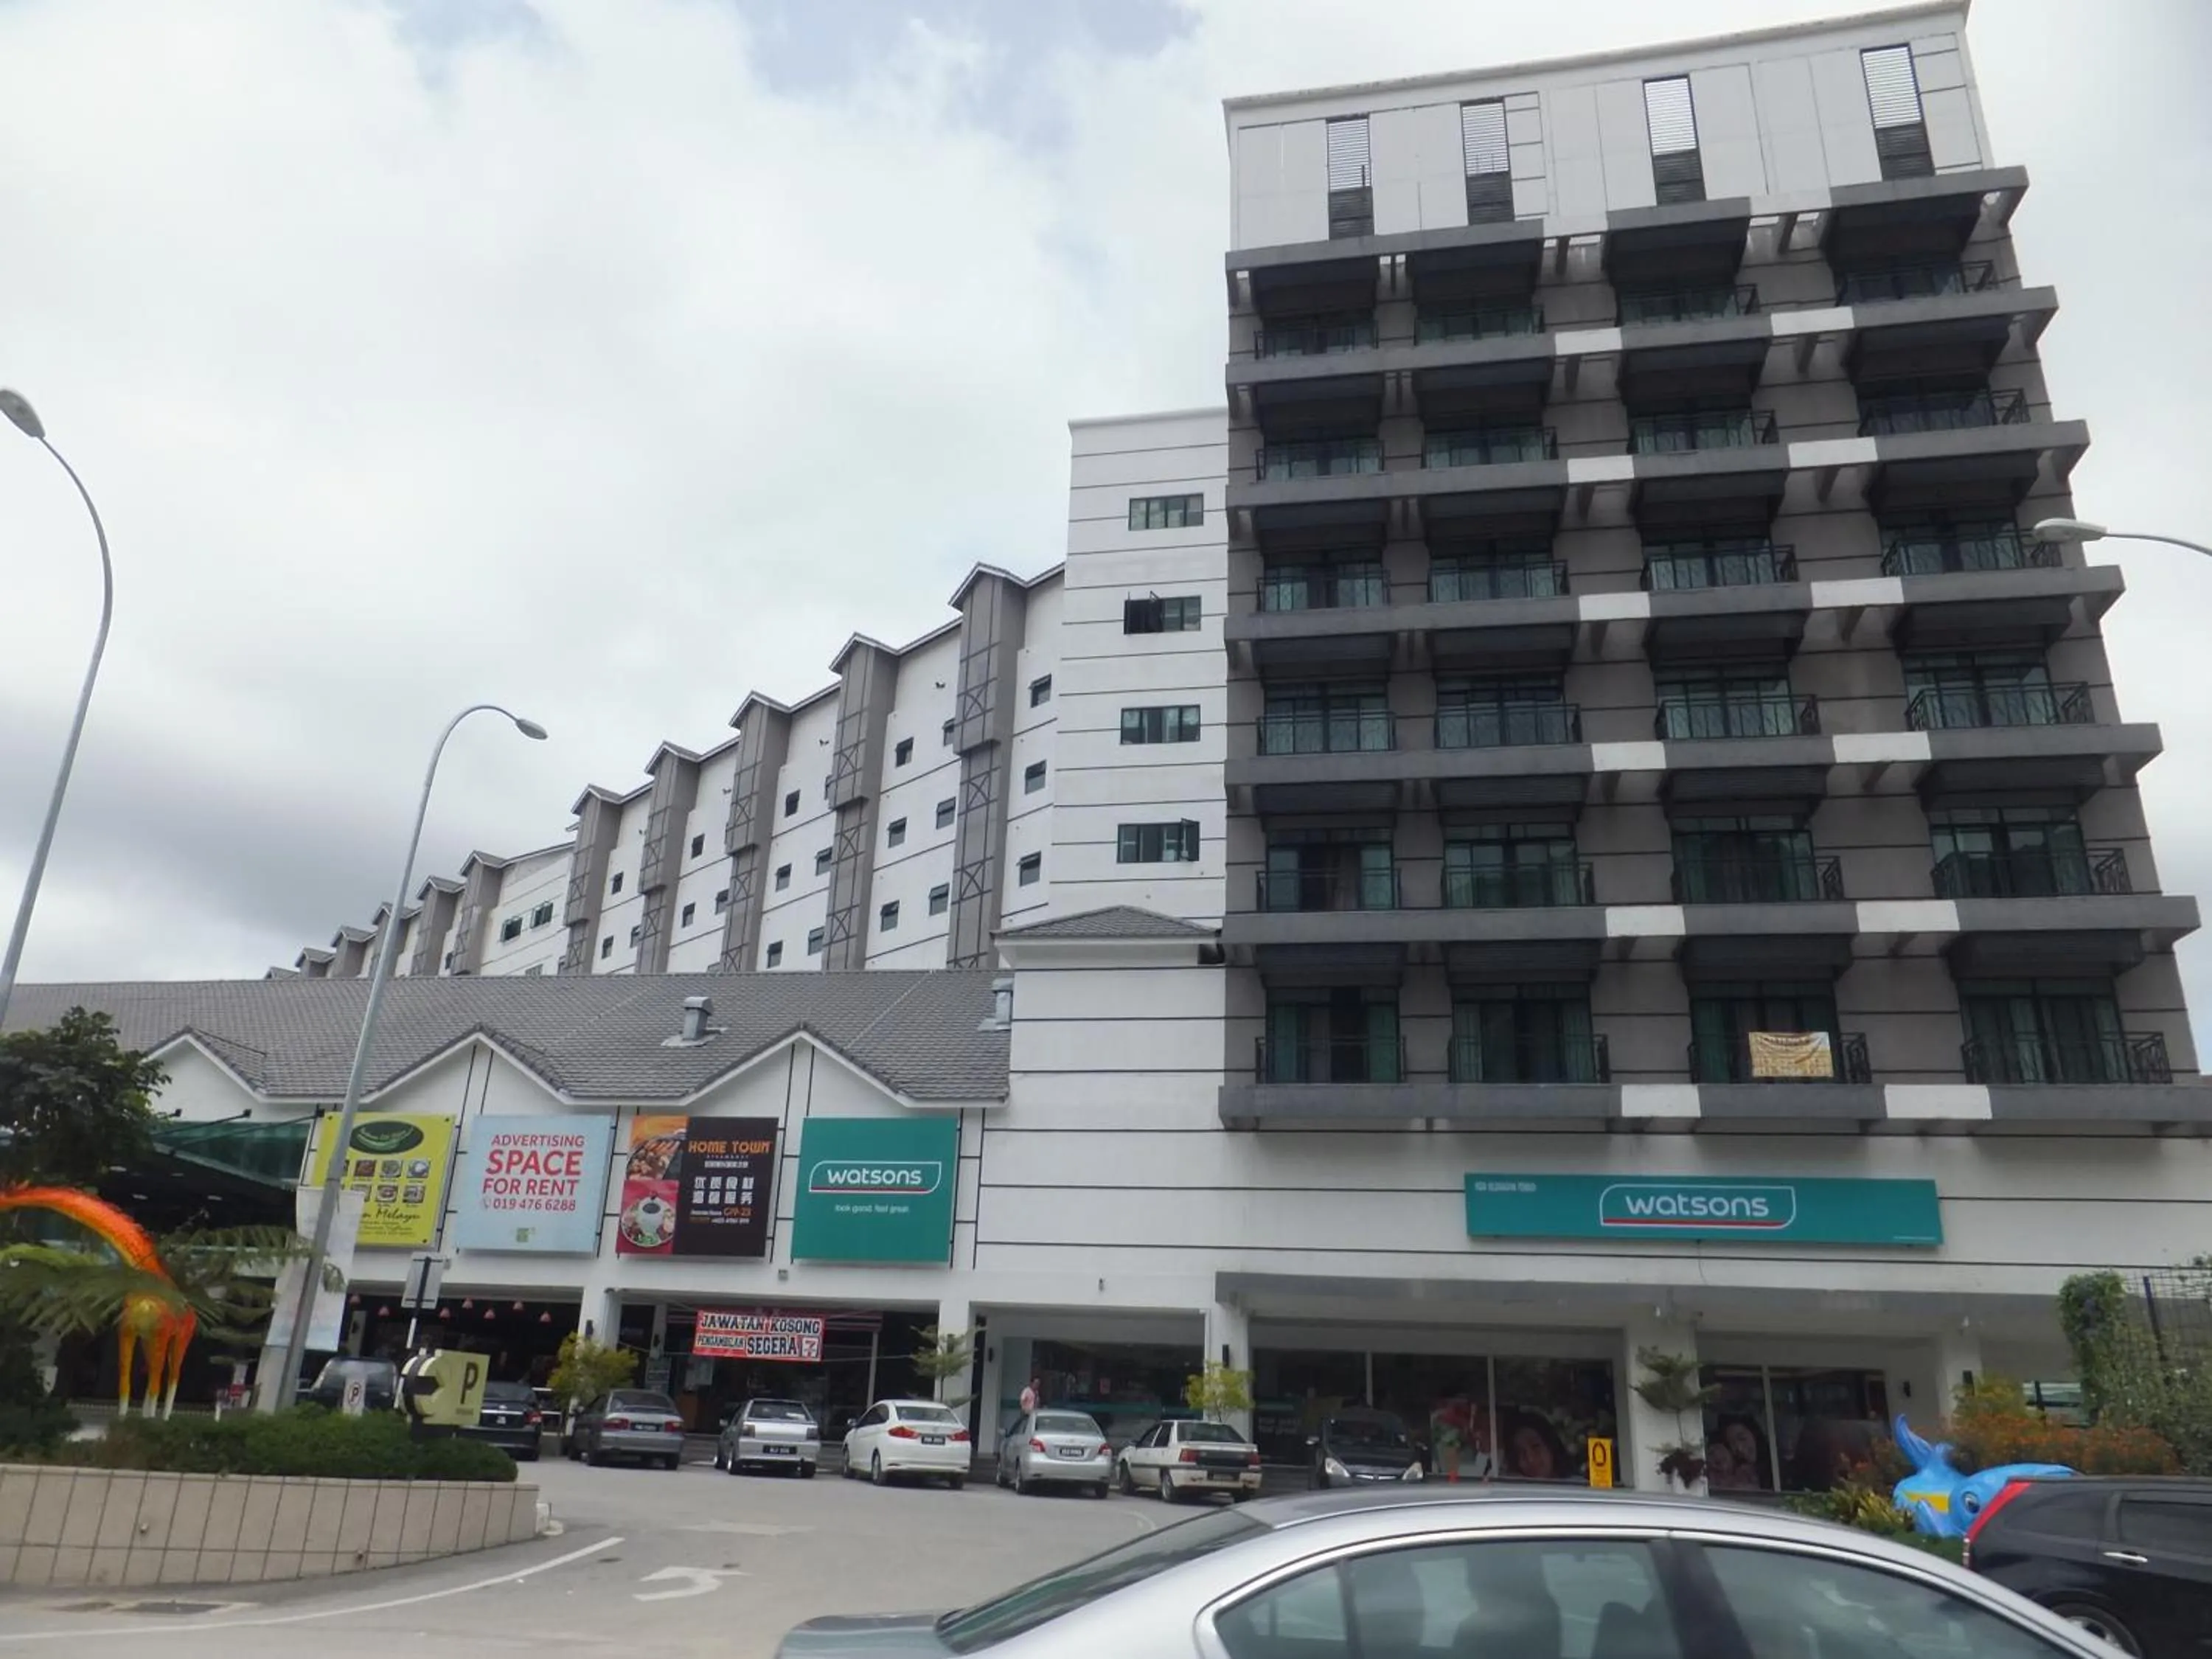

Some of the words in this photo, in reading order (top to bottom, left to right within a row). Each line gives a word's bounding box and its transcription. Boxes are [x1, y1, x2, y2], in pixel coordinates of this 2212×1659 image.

[491, 1134, 585, 1147] ADVERTISING
[688, 1140, 727, 1154] HOME
[731, 1141, 771, 1154] TOWN
[485, 1149, 584, 1176] SPACE
[827, 1167, 922, 1186] watsons
[482, 1177, 521, 1195] FOR
[526, 1178, 580, 1197] RENT
[493, 1197, 517, 1210] 019
[519, 1198, 543, 1211] 476
[544, 1199, 577, 1211] 6288
[1624, 1192, 1770, 1217] watsons
[702, 1315, 764, 1331] JAWATAN
[770, 1318, 820, 1334] KOSONG
[746, 1335, 798, 1356] SEGERA
[460, 1362, 479, 1405] P
